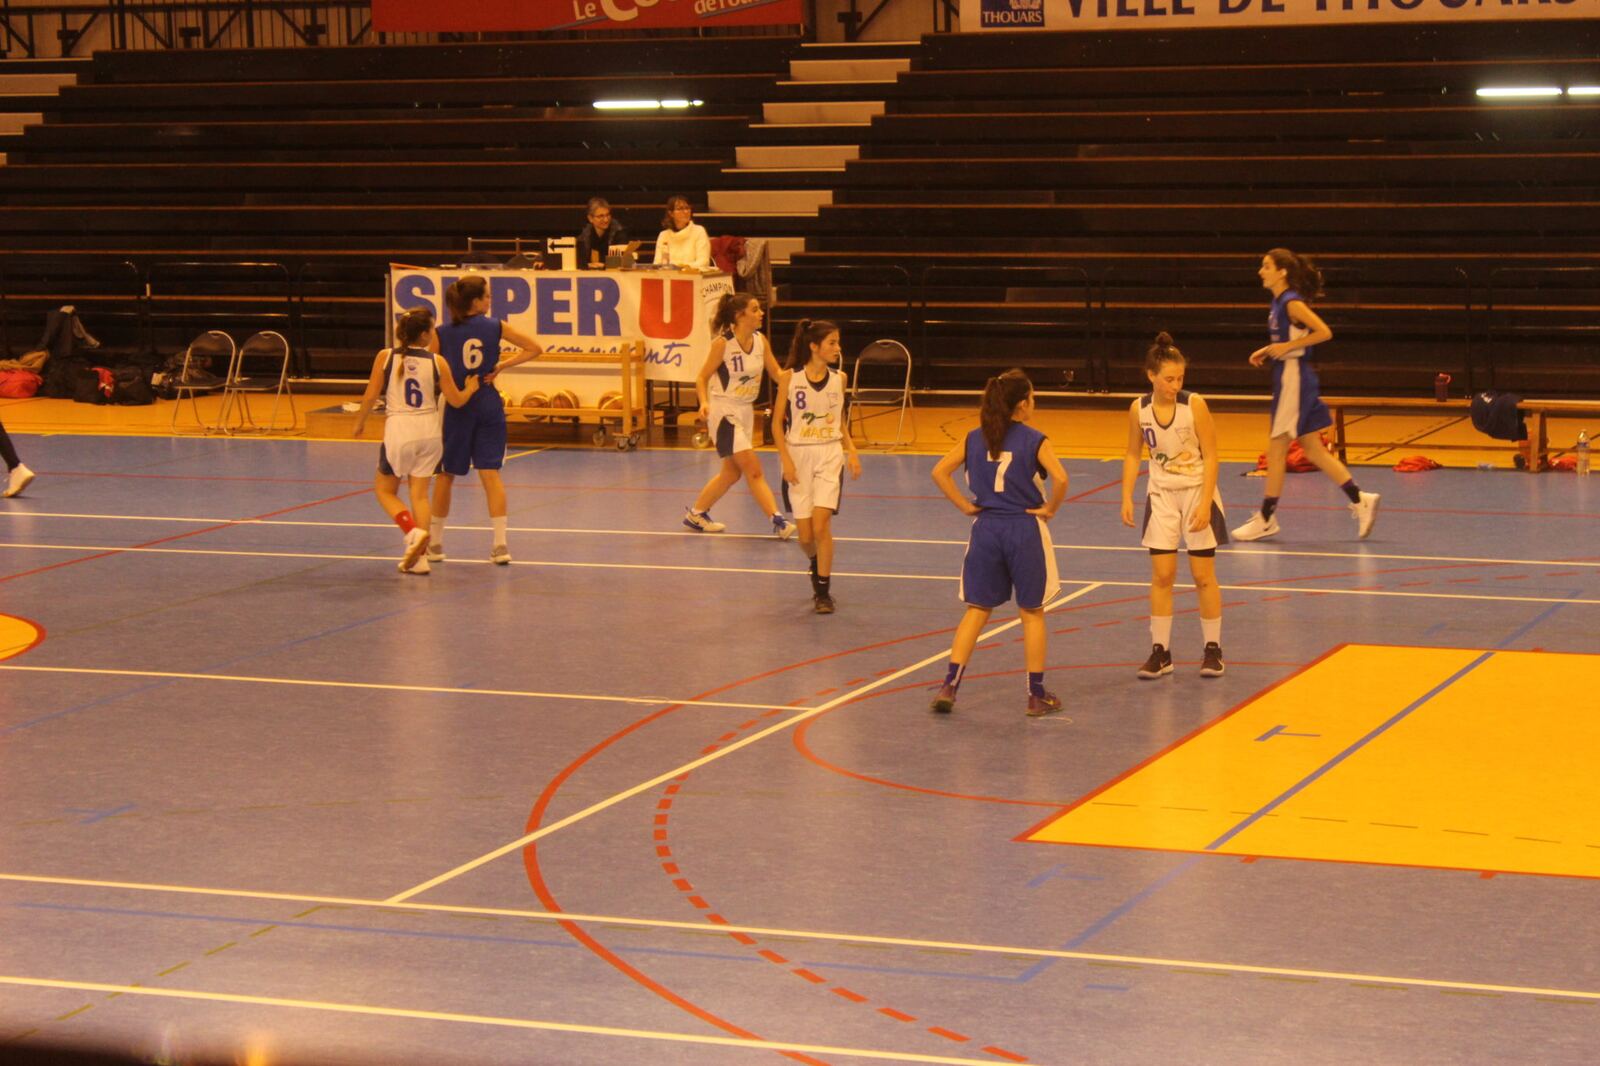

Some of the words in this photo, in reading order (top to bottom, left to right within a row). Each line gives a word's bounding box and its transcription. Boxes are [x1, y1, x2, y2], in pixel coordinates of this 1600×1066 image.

[573, 0, 597, 21] Le
[981, 11, 1043, 24] THOUARS
[639, 278, 694, 340] U
[462, 338, 484, 370] 6
[730, 355, 745, 372] 11
[404, 377, 424, 408] 6
[795, 390, 807, 410] 8
[986, 450, 1013, 493] 7
